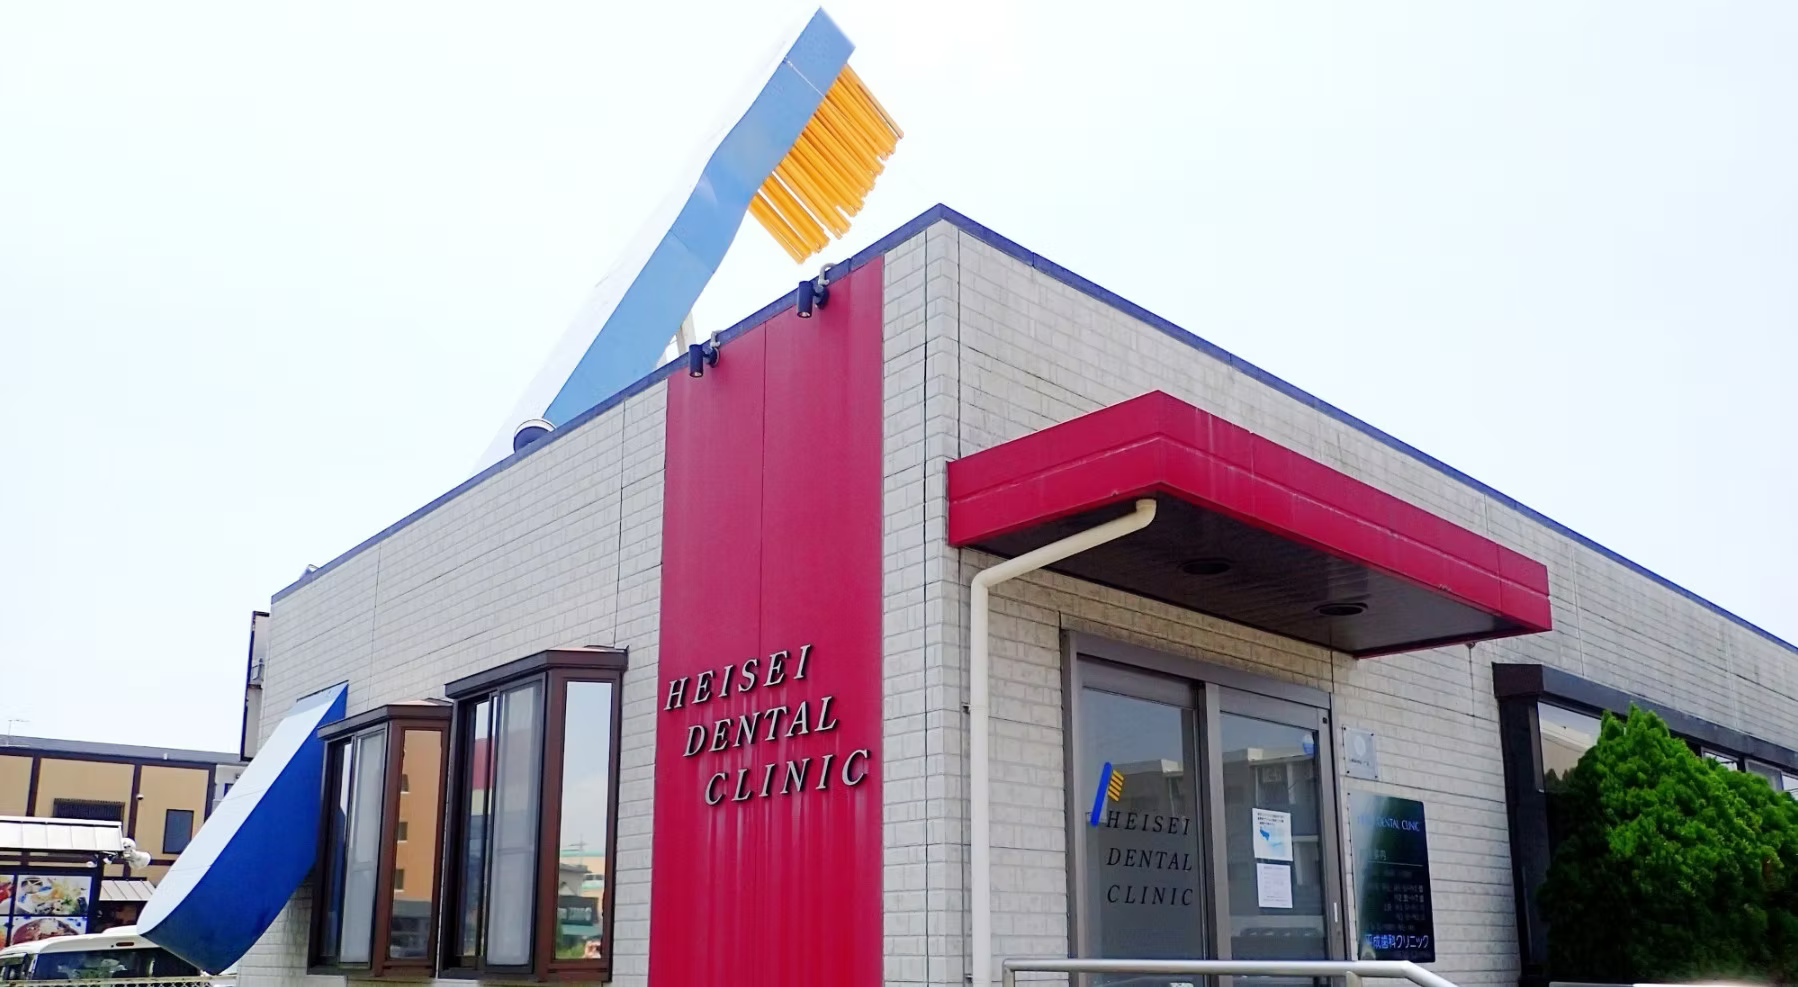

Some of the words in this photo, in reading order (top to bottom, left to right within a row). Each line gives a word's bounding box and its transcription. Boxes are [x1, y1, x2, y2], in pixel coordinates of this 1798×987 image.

[664, 644, 812, 711] HEISEI
[683, 696, 838, 757] DENTAL
[705, 749, 869, 806] CLINIC
[1106, 810, 1191, 835] HEISEI
[1401, 819, 1420, 831] CLINIC
[1107, 848, 1193, 871] DENTAL
[1107, 884, 1193, 906] CLINIC
